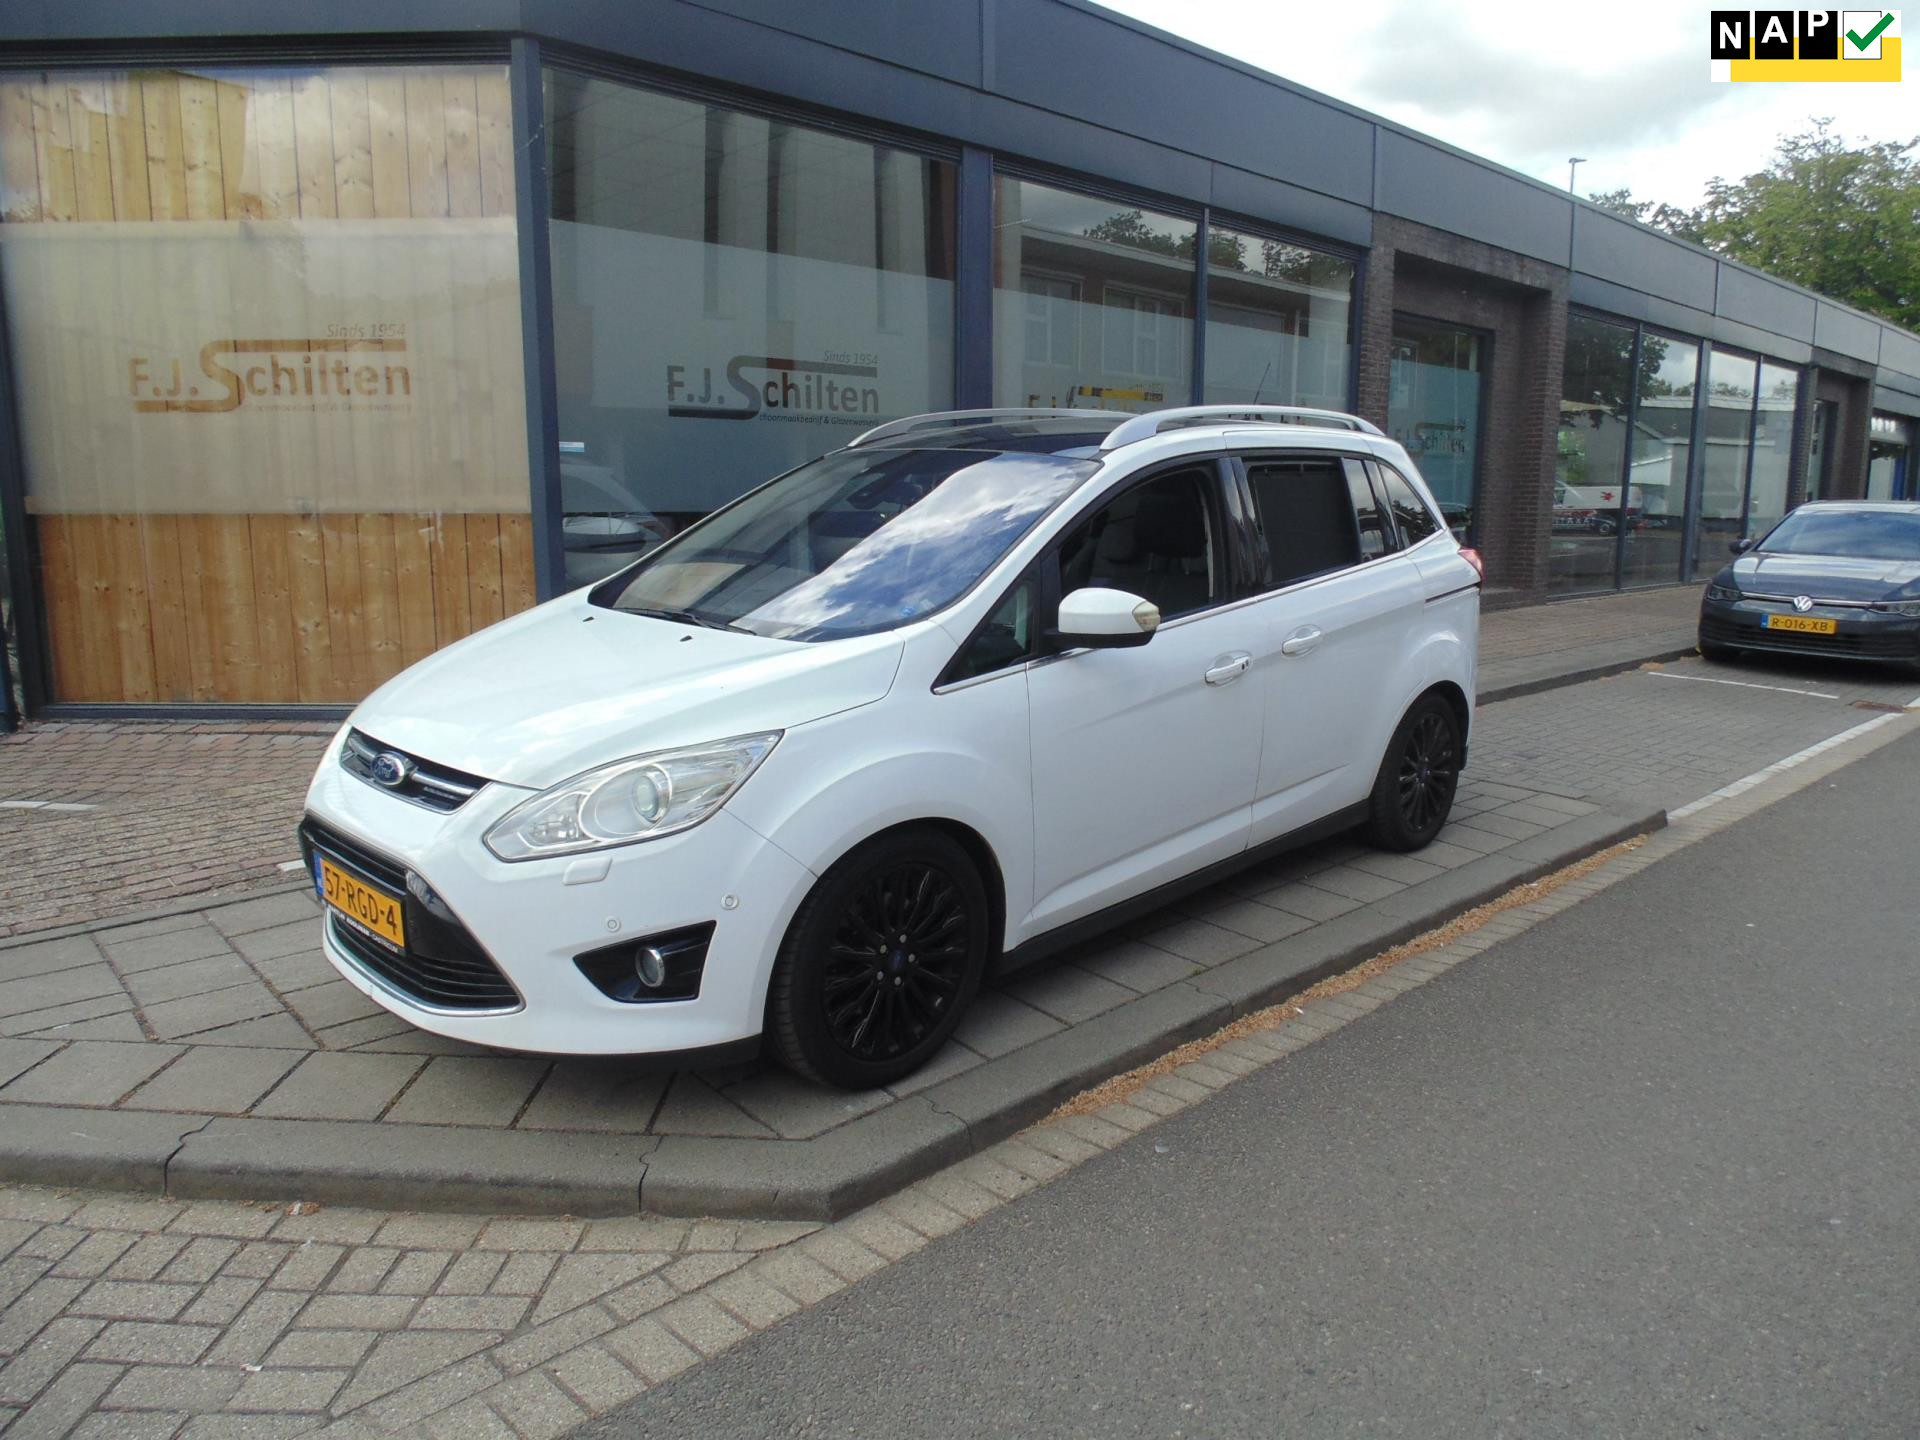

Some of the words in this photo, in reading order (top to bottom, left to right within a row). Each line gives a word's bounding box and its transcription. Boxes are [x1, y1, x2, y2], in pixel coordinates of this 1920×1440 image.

[327, 324, 365, 338] Sinds
[371, 324, 407, 338] 1954
[128, 357, 199, 397] F.J.
[199, 340, 411, 412] Schilten
[823, 350, 850, 364] Sinds
[854, 352, 879, 365] 1954
[667, 365, 725, 404] F.J.
[726, 355, 879, 420] Schilten
[1771, 617, 1829, 632] R-016-XB
[324, 866, 398, 937] 57-RGD-4
